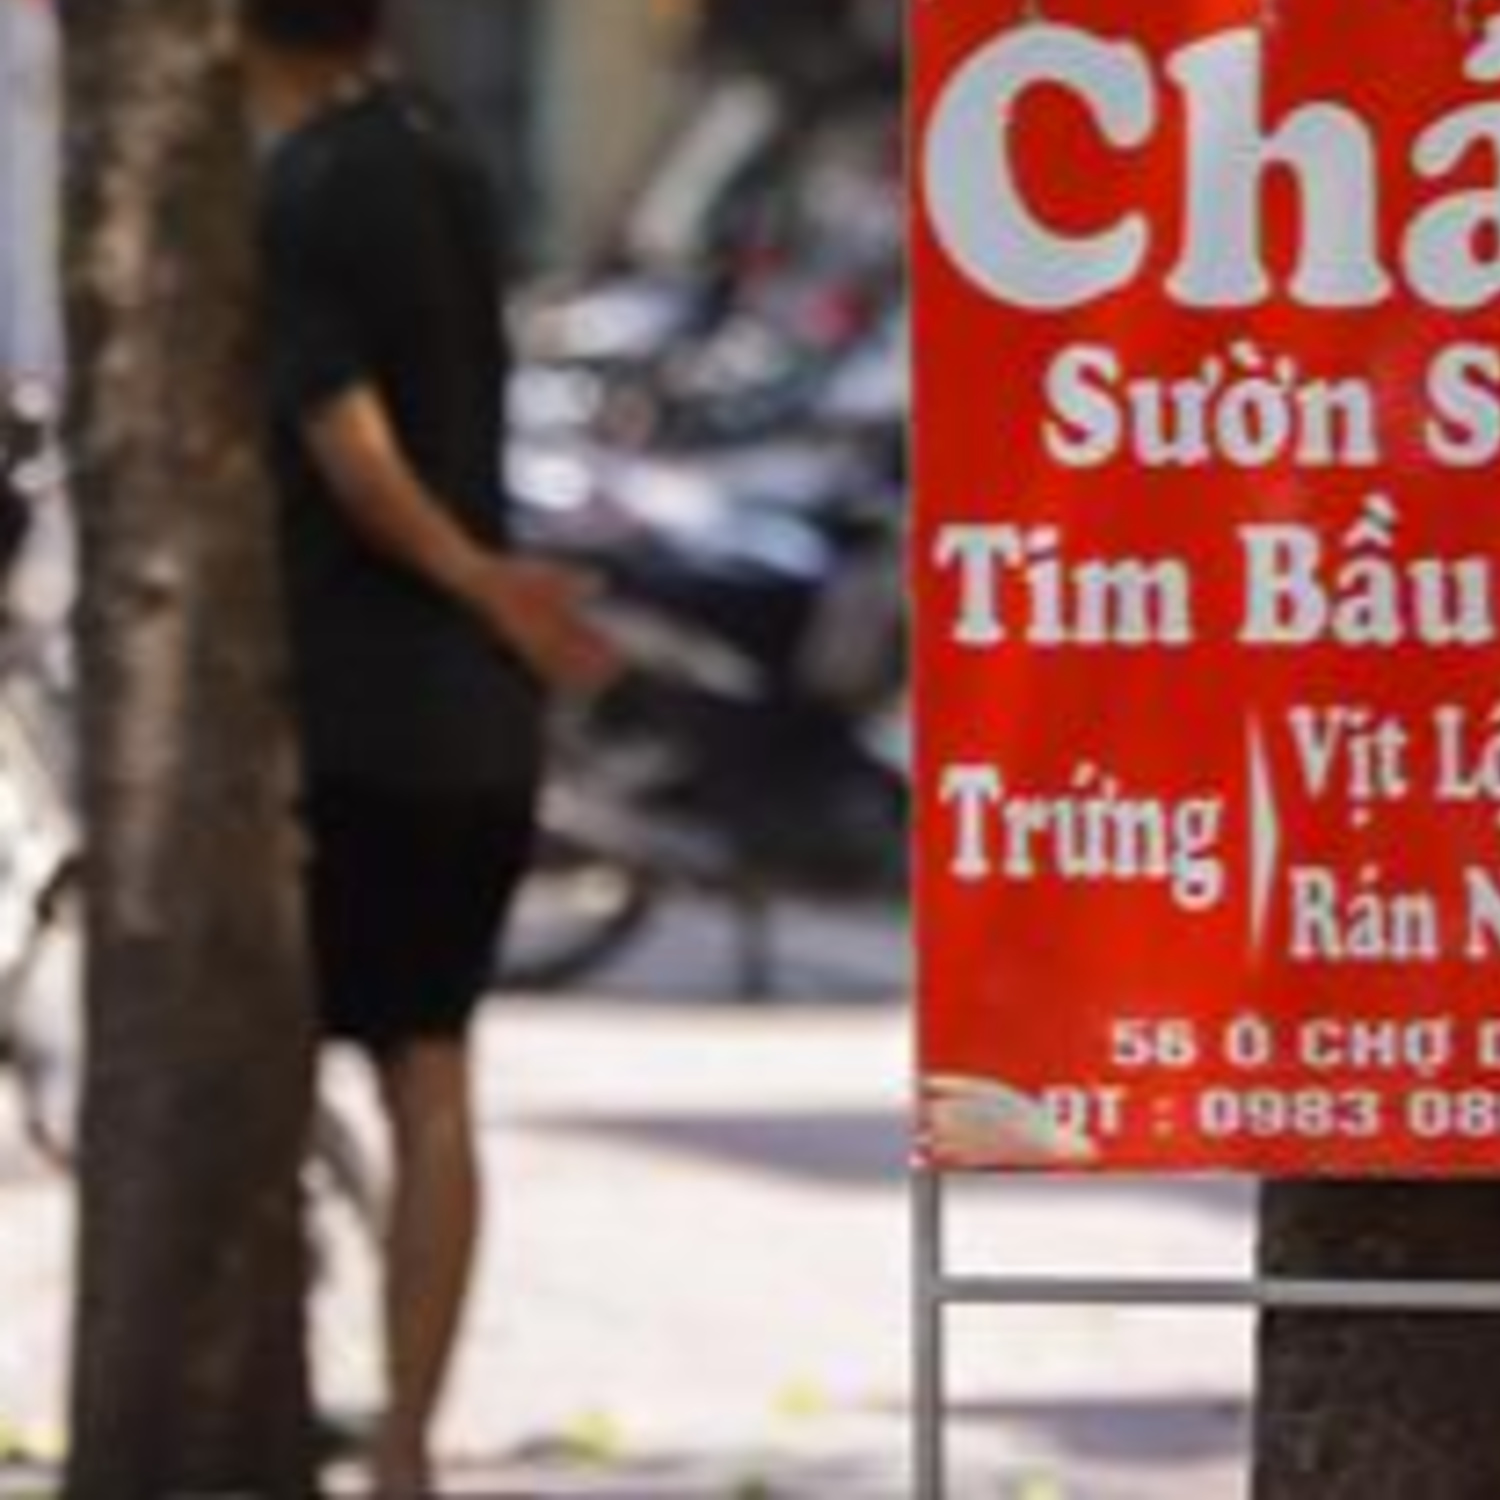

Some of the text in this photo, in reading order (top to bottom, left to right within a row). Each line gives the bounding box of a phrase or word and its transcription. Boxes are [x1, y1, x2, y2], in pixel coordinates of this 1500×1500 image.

[1044, 340, 1380, 468] Sườn
[934, 522, 1193, 647] Tim
[1238, 492, 1495, 646] Bầu
[1288, 705, 1407, 826] Vịt
[939, 763, 1225, 910] Trứng
[1289, 861, 1440, 961] Rán
[1197, 1087, 1382, 1138] 0983
